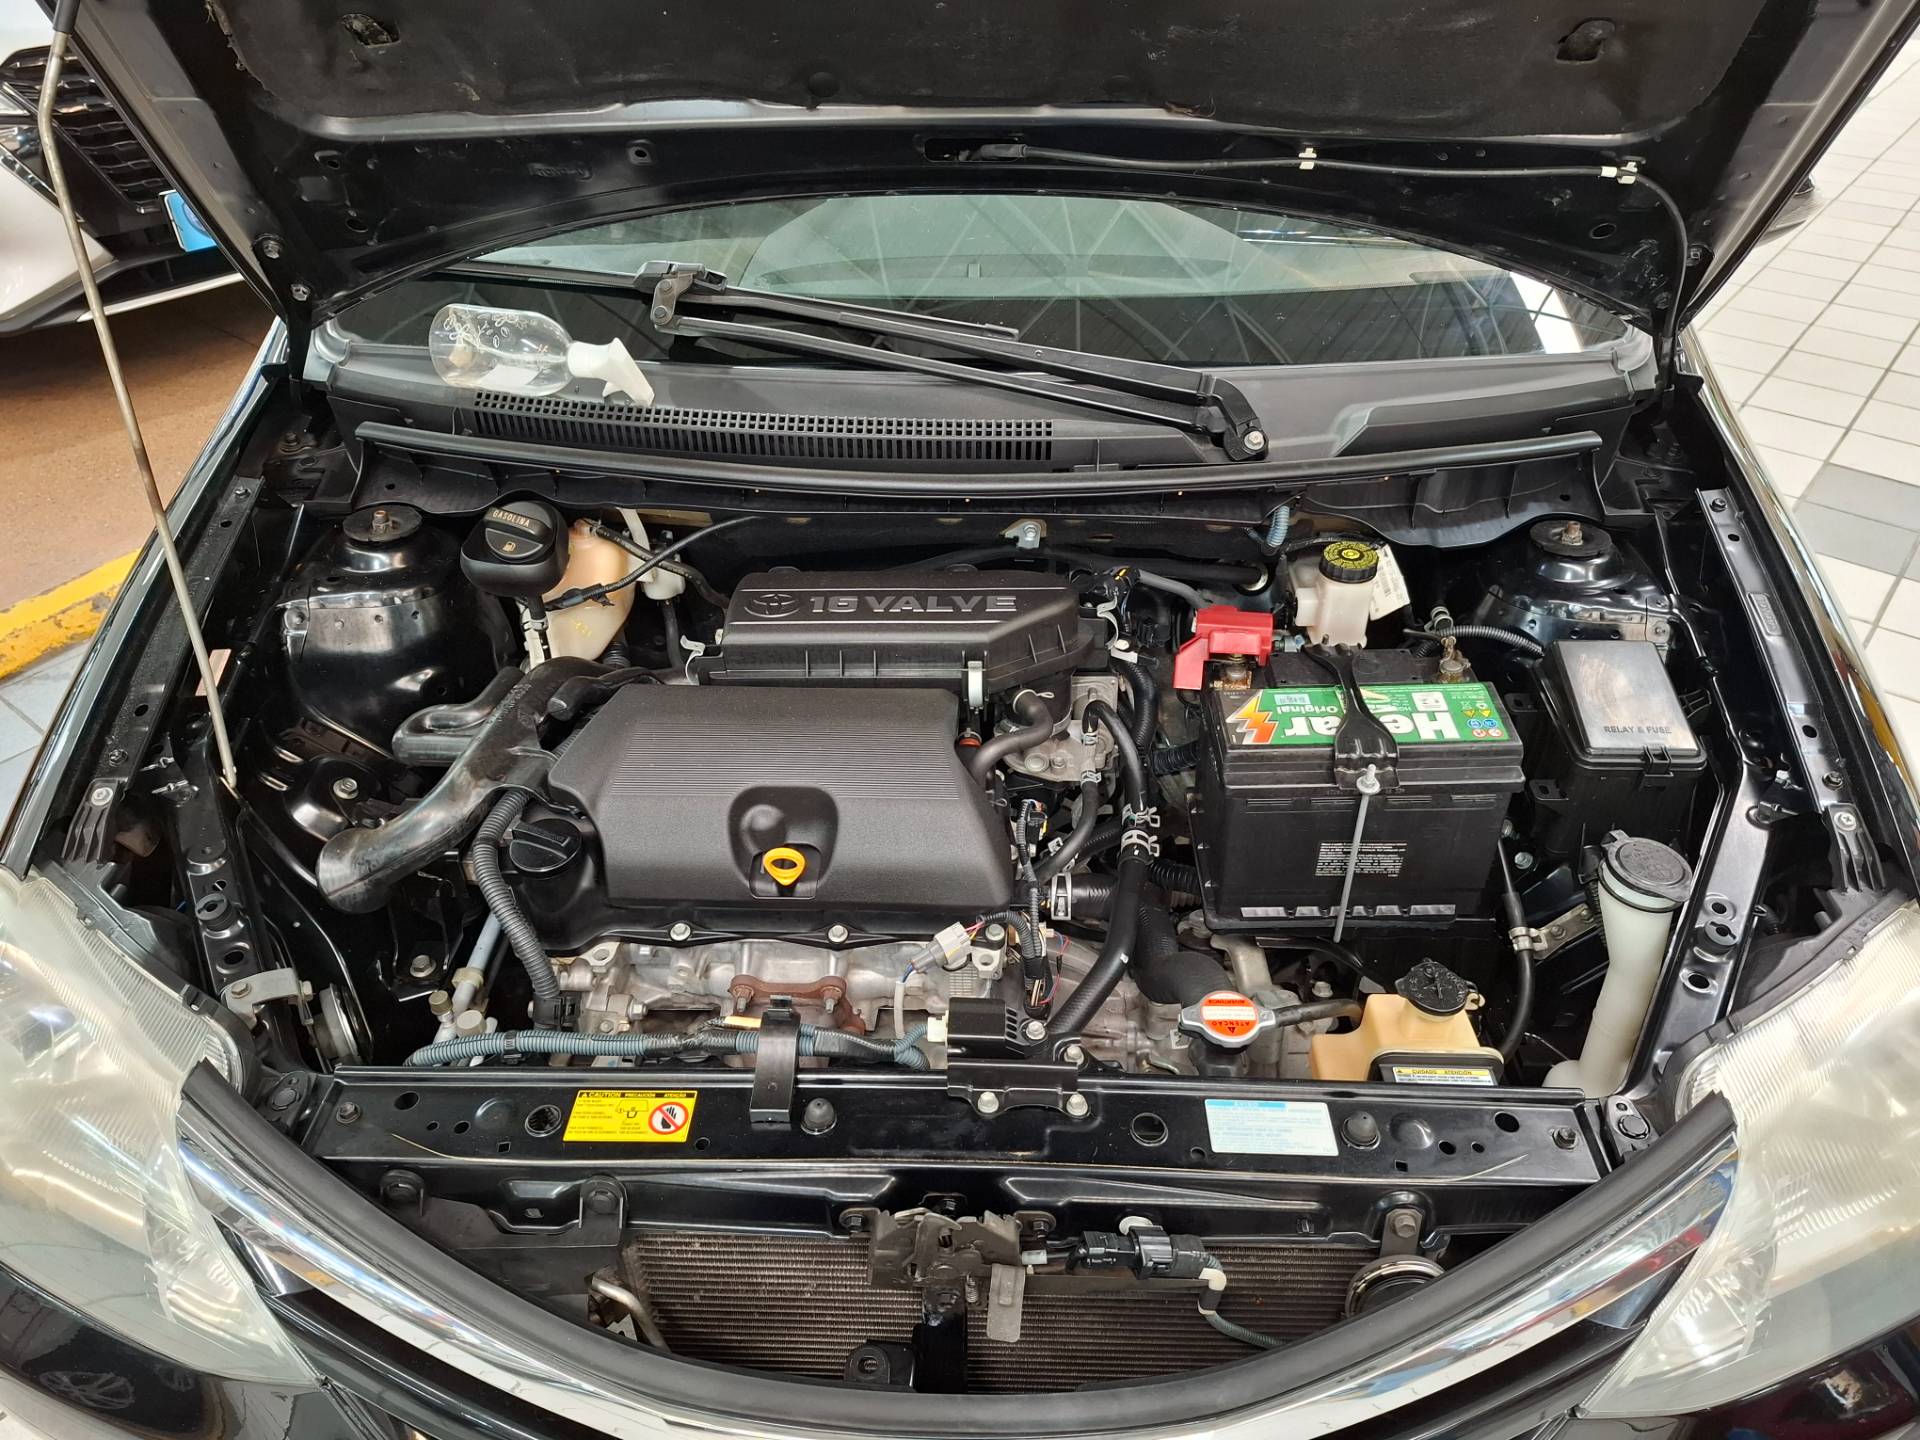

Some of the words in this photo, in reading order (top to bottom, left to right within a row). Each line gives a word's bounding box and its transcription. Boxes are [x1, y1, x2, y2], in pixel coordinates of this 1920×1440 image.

[492, 509, 530, 528] GASOLINA
[810, 596, 858, 613] 16
[864, 596, 1017, 613] VALVE
[1276, 704, 1338, 714] Original
[1284, 712, 1461, 740] Hear
[1603, 725, 1634, 734] RELAY
[1646, 725, 1672, 734] FUSE
